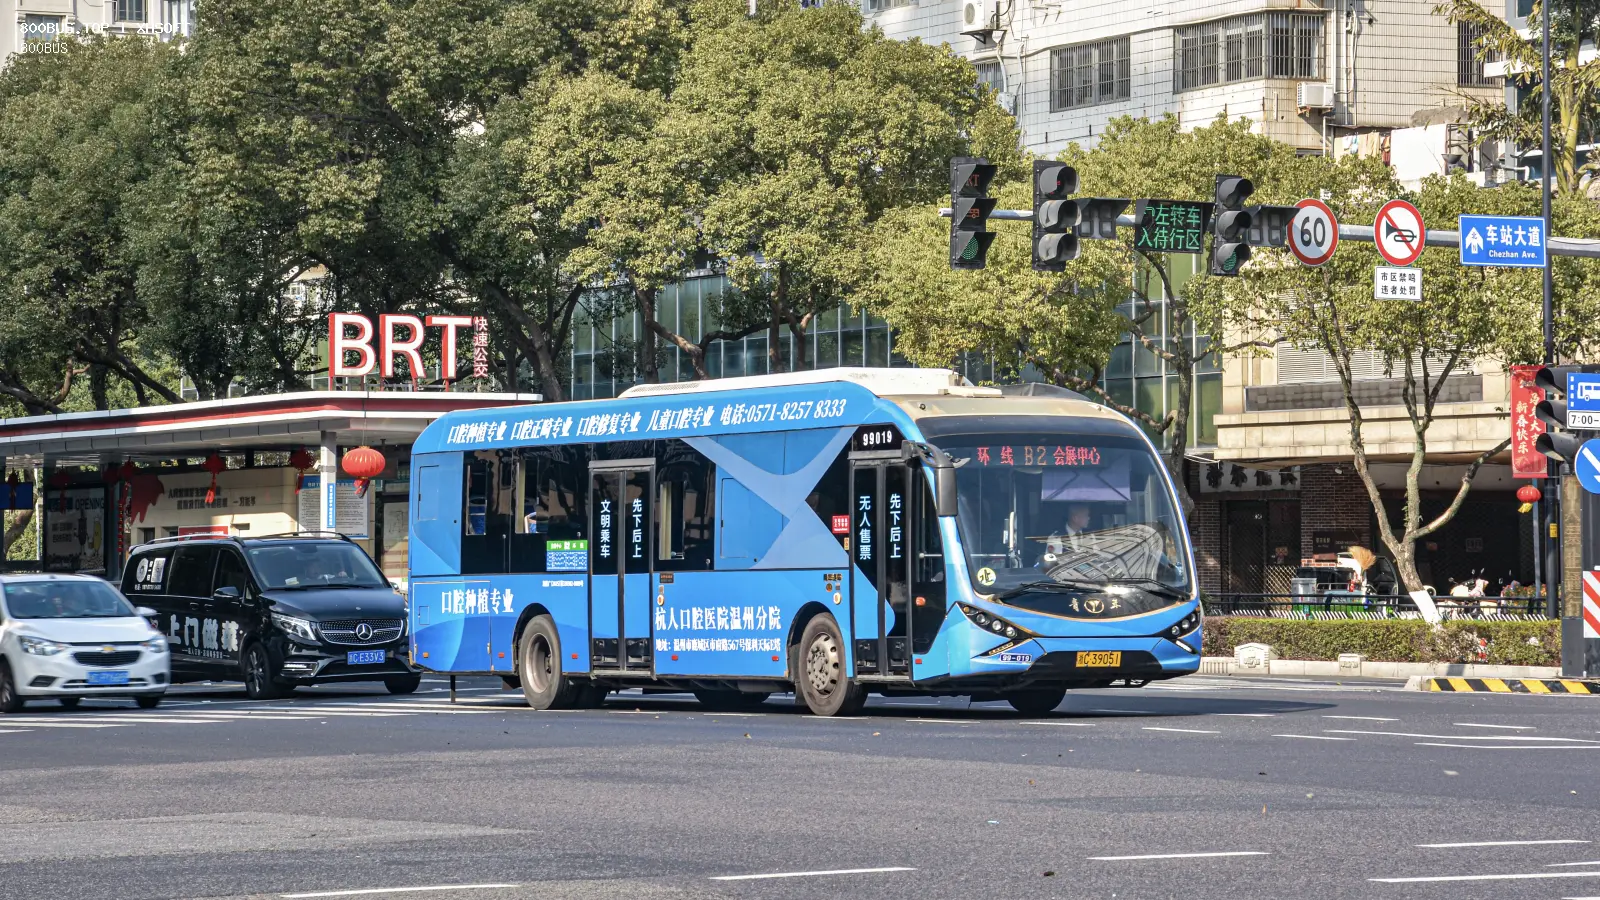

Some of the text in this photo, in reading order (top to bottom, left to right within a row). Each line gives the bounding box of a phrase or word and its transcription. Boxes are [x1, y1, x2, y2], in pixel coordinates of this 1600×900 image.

[1155, 203, 1201, 227] 左转车
[1137, 226, 1201, 250] 入待行区
[1300, 215, 1326, 248] 60
[1486, 224, 1541, 247] 车站大道
[1488, 249, 1538, 259] Chezhan Ave.
[1380, 272, 1416, 283] 市区禁鸣
[1380, 285, 1416, 296] 违者处罚
[328, 312, 473, 379] BRT
[473, 316, 489, 378] 快速公交
[447, 420, 508, 444] 口腔种植专业
[576, 411, 642, 436] 口腔修复专业
[646, 405, 715, 433] 儿童口腔专业
[814, 398, 847, 418] 8333
[1516, 400, 1529, 455] 新春快乐
[862, 430, 893, 446] 99019
[1024, 445, 1048, 466] B2
[1053, 445, 1101, 466] 会展中心
[600, 499, 611, 559] 文明乘车
[632, 498, 643, 559] 先下后上
[859, 495, 872, 561] 无人售票
[889, 493, 902, 559] 先下后上
[441, 588, 515, 615] 口腔种植专业
[655, 605, 782, 631] 杭人口腔医院温州分院
[1002, 654, 1030, 662] 99-019
